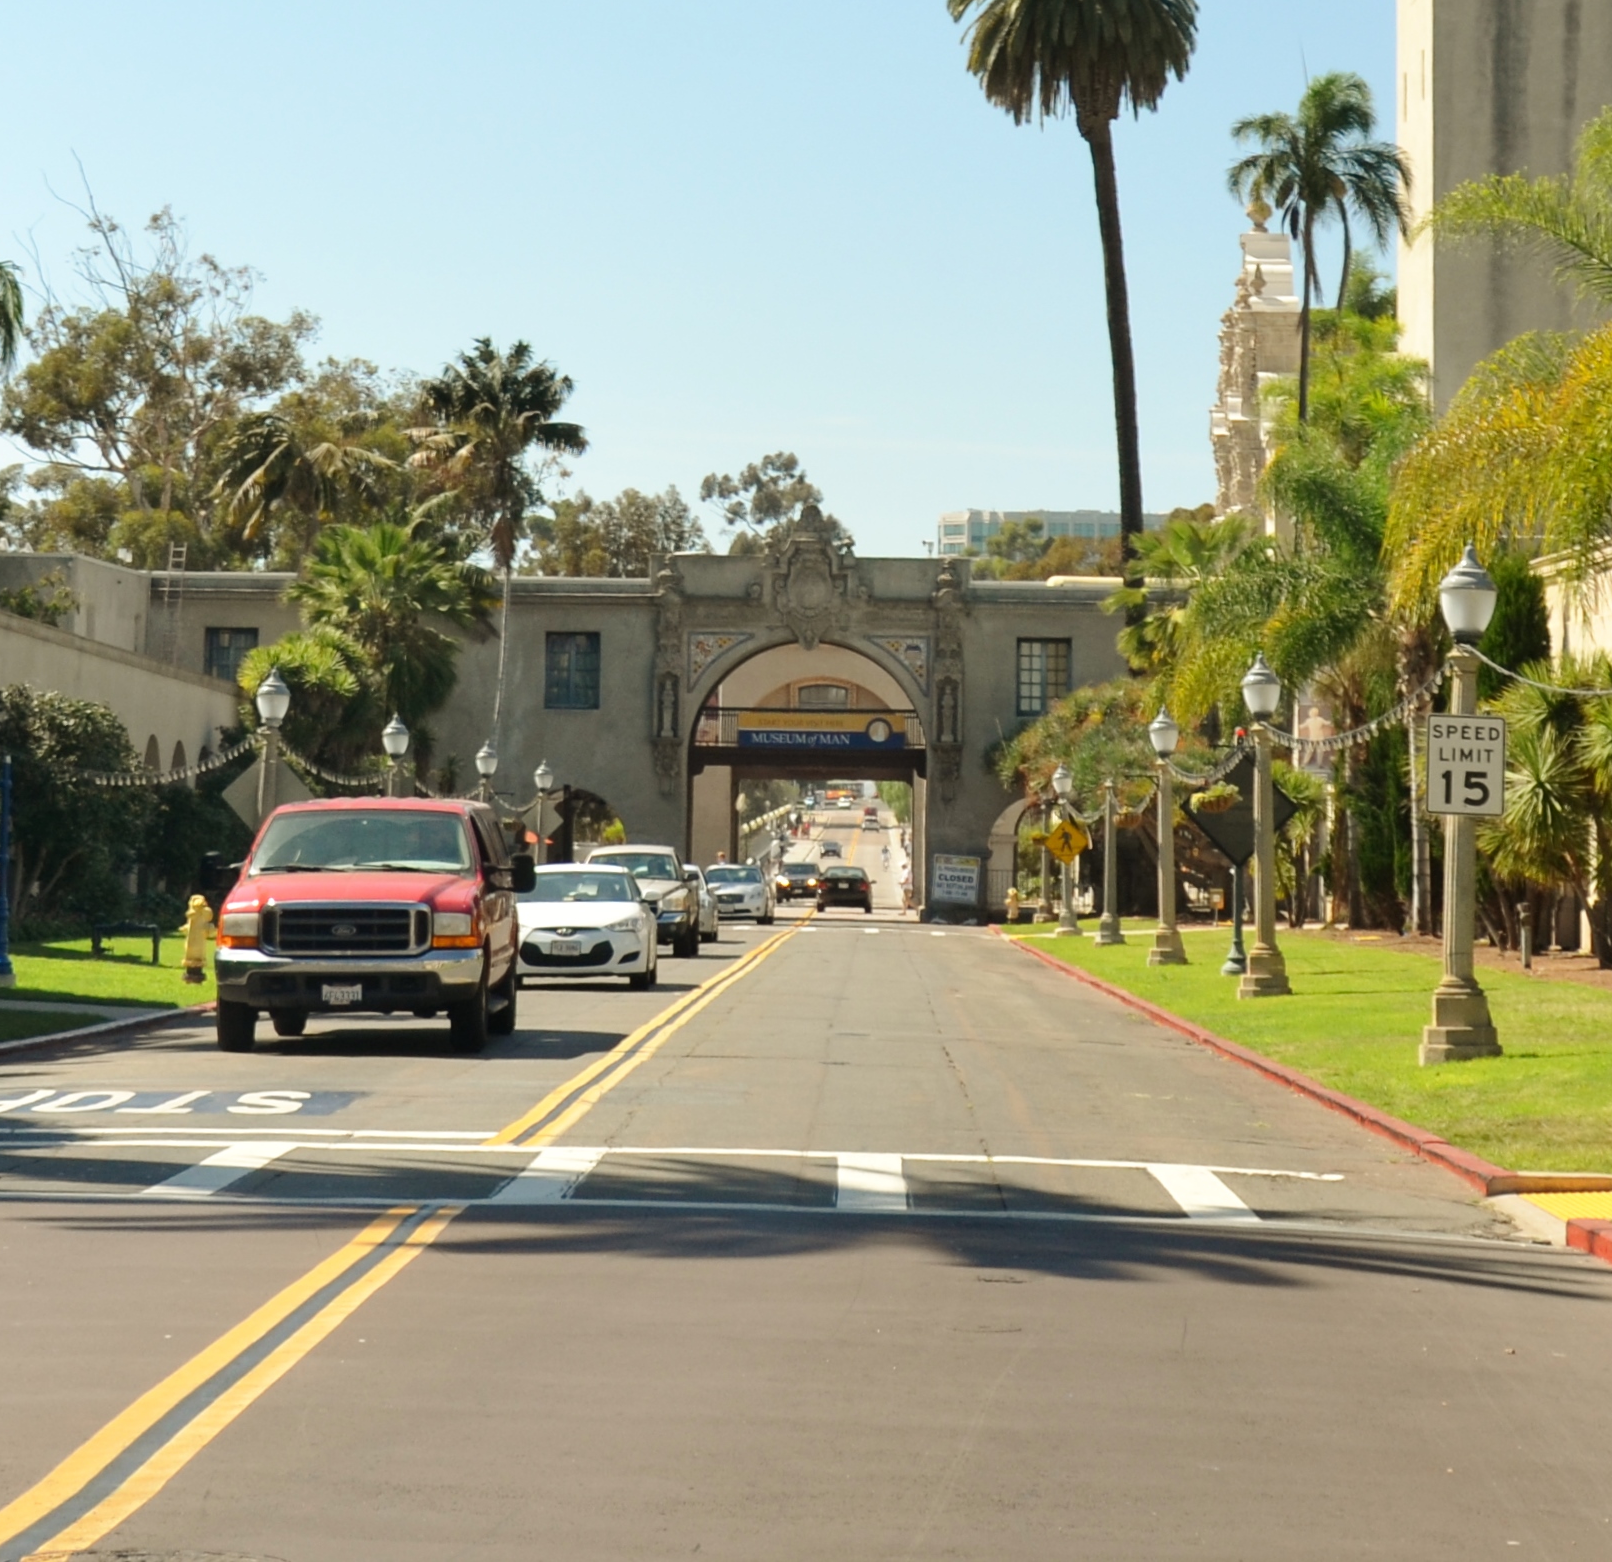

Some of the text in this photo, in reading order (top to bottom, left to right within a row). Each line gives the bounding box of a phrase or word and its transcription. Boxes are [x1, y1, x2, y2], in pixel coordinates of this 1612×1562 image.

[751, 732, 851, 746] MUSEUM of MAN
[1432, 724, 1500, 741] SPEED
[1439, 747, 1494, 763] LIMIT
[1441, 770, 1490, 807] 15
[938, 874, 974, 884] CLOSED
